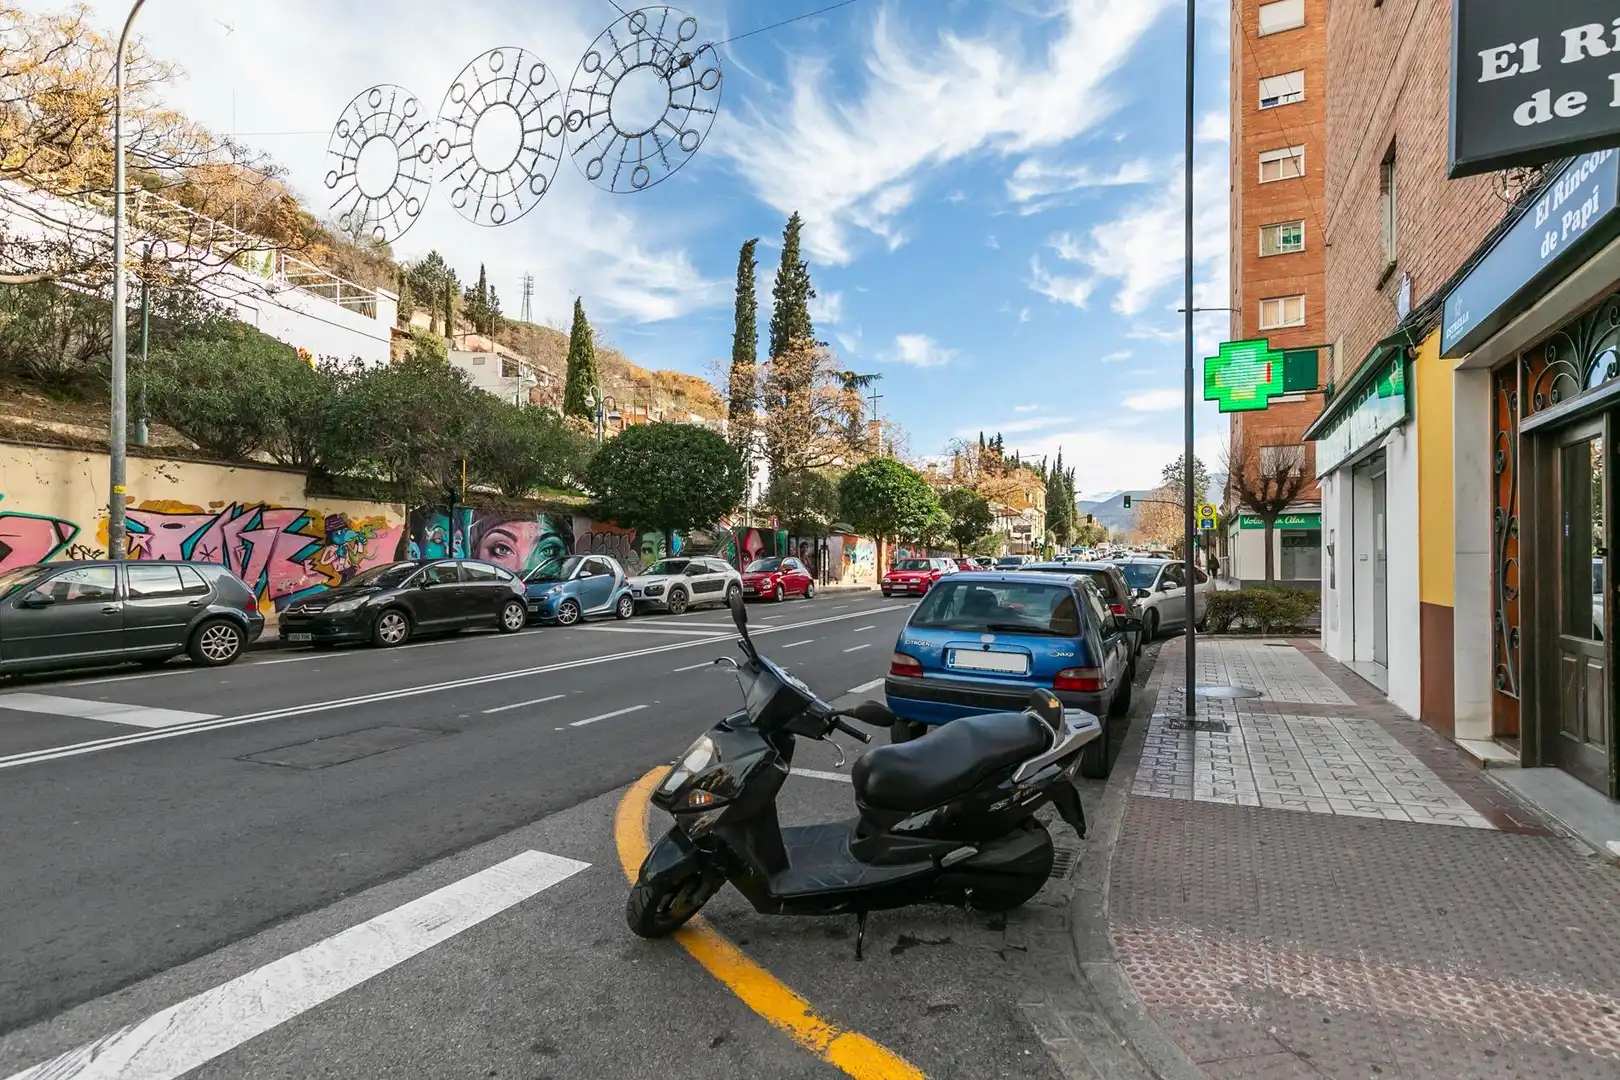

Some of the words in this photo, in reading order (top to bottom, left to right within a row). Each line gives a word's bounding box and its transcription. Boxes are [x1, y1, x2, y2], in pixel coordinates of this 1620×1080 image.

[1478, 37, 1541, 83] El
[1513, 88, 1588, 127] de
[1534, 194, 1550, 230] El
[1540, 230, 1558, 259] de
[1561, 184, 1600, 241] Papi
